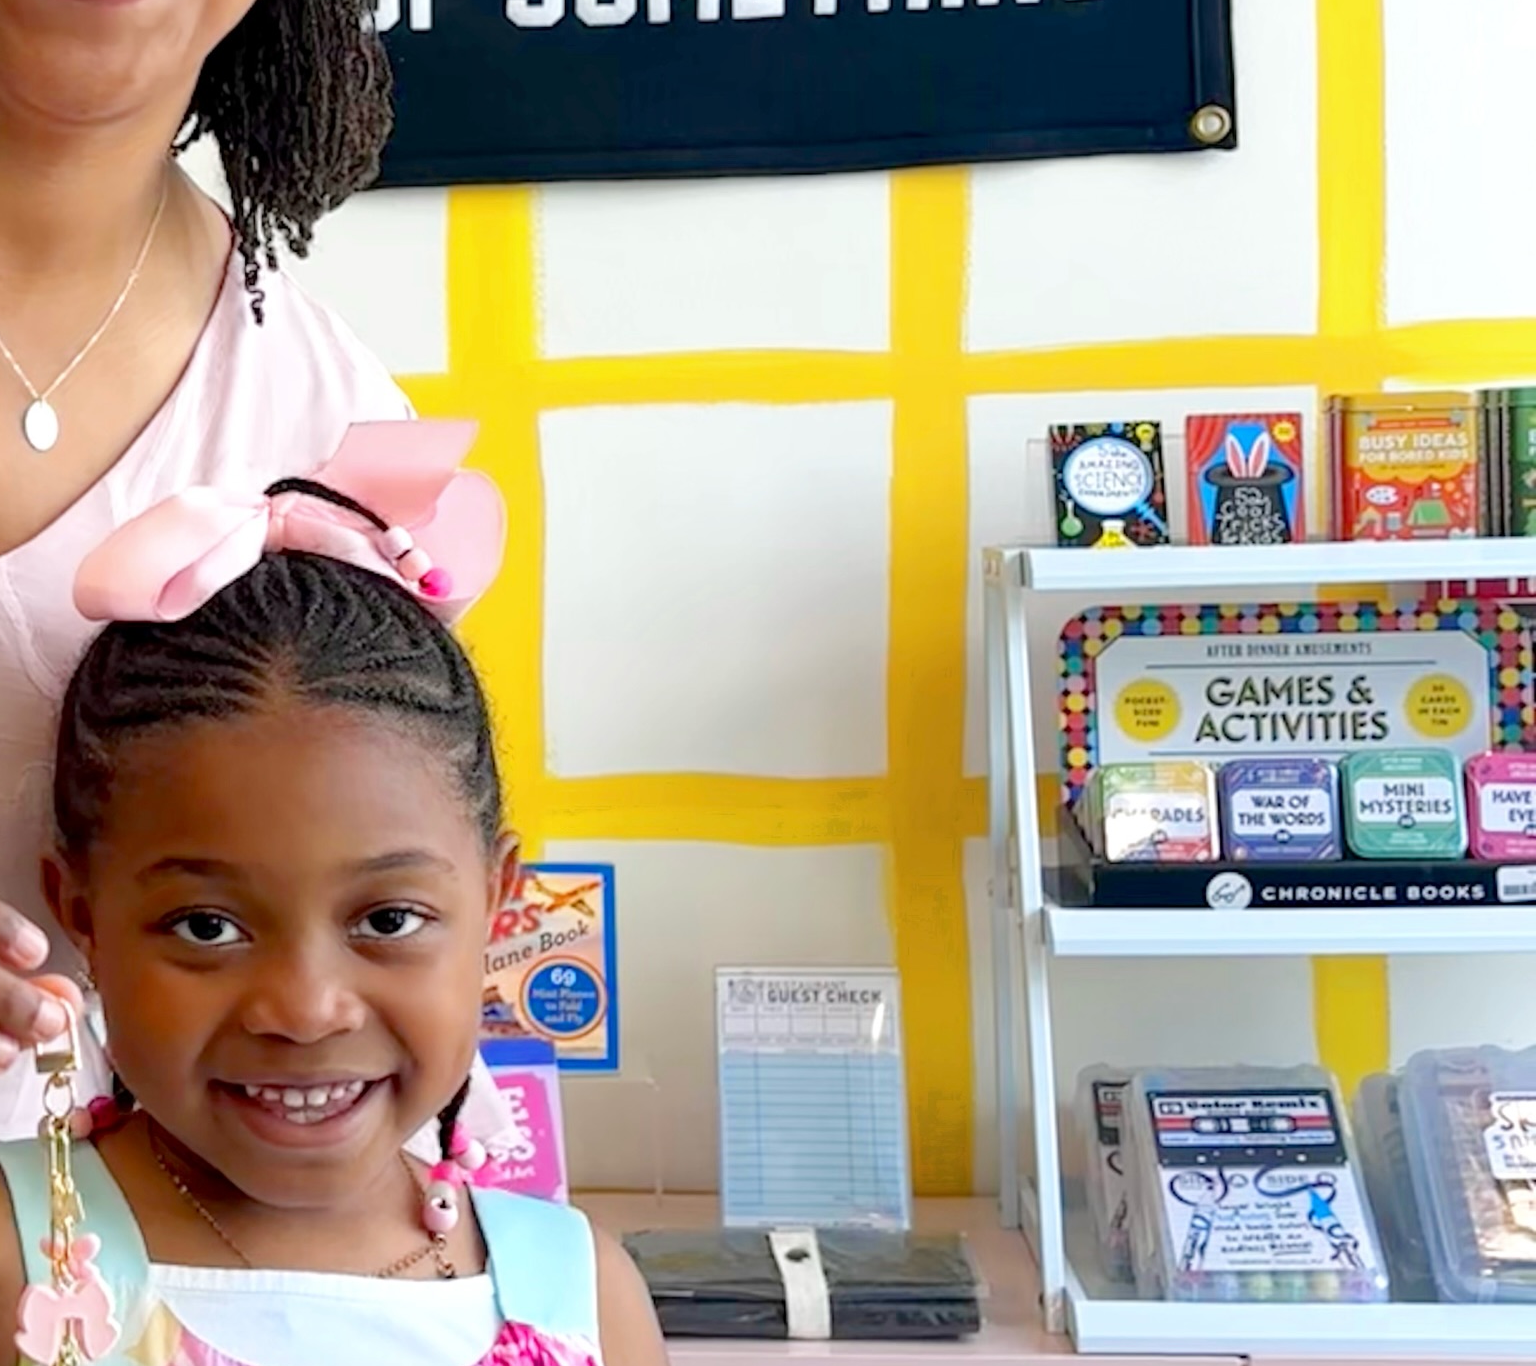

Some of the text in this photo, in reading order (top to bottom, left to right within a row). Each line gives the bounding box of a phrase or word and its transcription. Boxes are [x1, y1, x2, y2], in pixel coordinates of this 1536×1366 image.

[1359, 432, 1469, 451] BUSY IDEAS
[1359, 446, 1469, 463] FOR BORED KIDS
[1206, 642, 1372, 657] AFTER DINNER AMUSEMENTS
[1205, 675, 1375, 708] GAMES &
[1194, 711, 1390, 743] ACTIVITIES
[1383, 783, 1425, 797] MINI
[1491, 790, 1531, 805] HAVE
[1250, 795, 1310, 809] WAR OF
[1359, 799, 1452, 815] MYSTERIES
[1238, 812, 1325, 826] THE WORDS
[1260, 884, 1485, 902] CHRONICLE BOOKS
[539, 920, 589, 953] Book
[551, 967, 576, 986] 69
[767, 990, 882, 1004] GUEST CHECK
